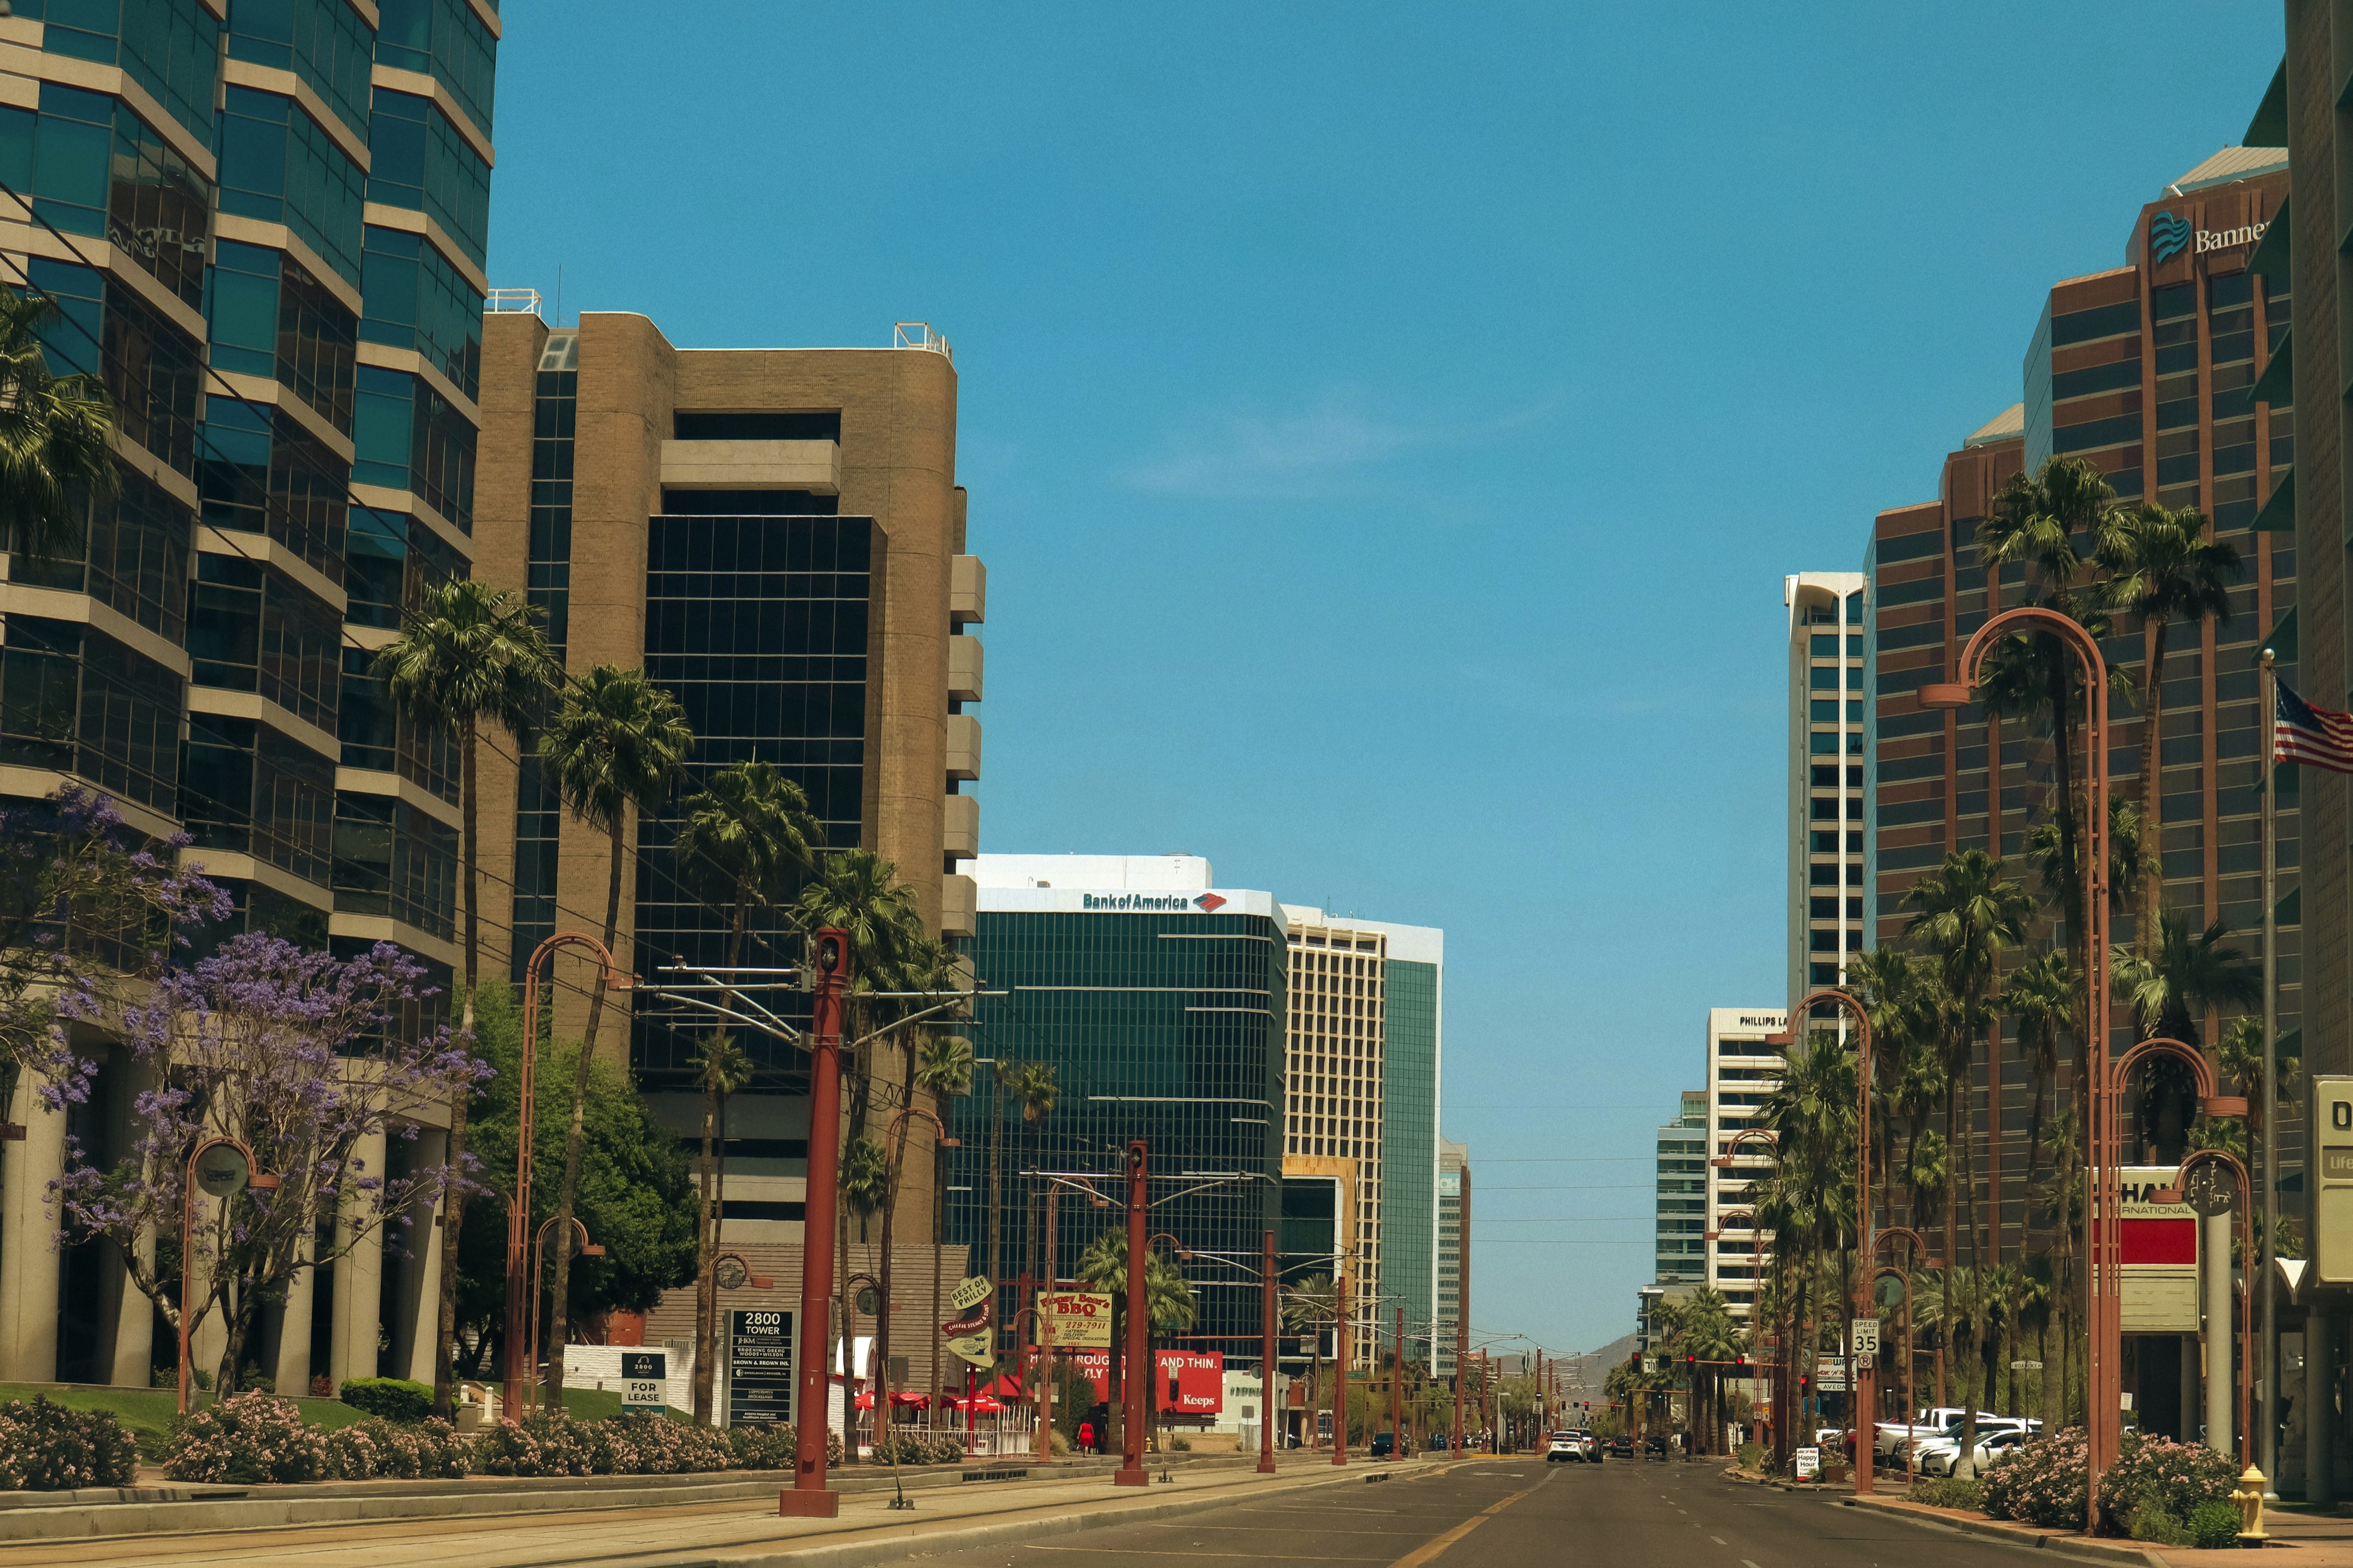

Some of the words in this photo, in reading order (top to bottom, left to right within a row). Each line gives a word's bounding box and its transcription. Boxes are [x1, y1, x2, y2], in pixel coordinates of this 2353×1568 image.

[1740, 1017, 1775, 1027] PHILLIPS
[952, 1285, 972, 1301] BEST
[974, 1277, 985, 1288] OF
[958, 1285, 987, 1307] PHILLY
[1057, 1303, 1096, 1317] BBQ
[745, 1312, 781, 1325] 2800
[967, 1319, 984, 1329] STEAKS
[745, 1326, 780, 1335] TOWER
[738, 1337, 755, 1345] JHKM
[1854, 1336, 1877, 1351] 35
[1160, 1357, 1184, 1367] AND
[1187, 1357, 1218, 1369] THIN.
[631, 1382, 656, 1392] FOR
[628, 1393, 659, 1402] LEASE
[1184, 1394, 1215, 1408] Keeps
